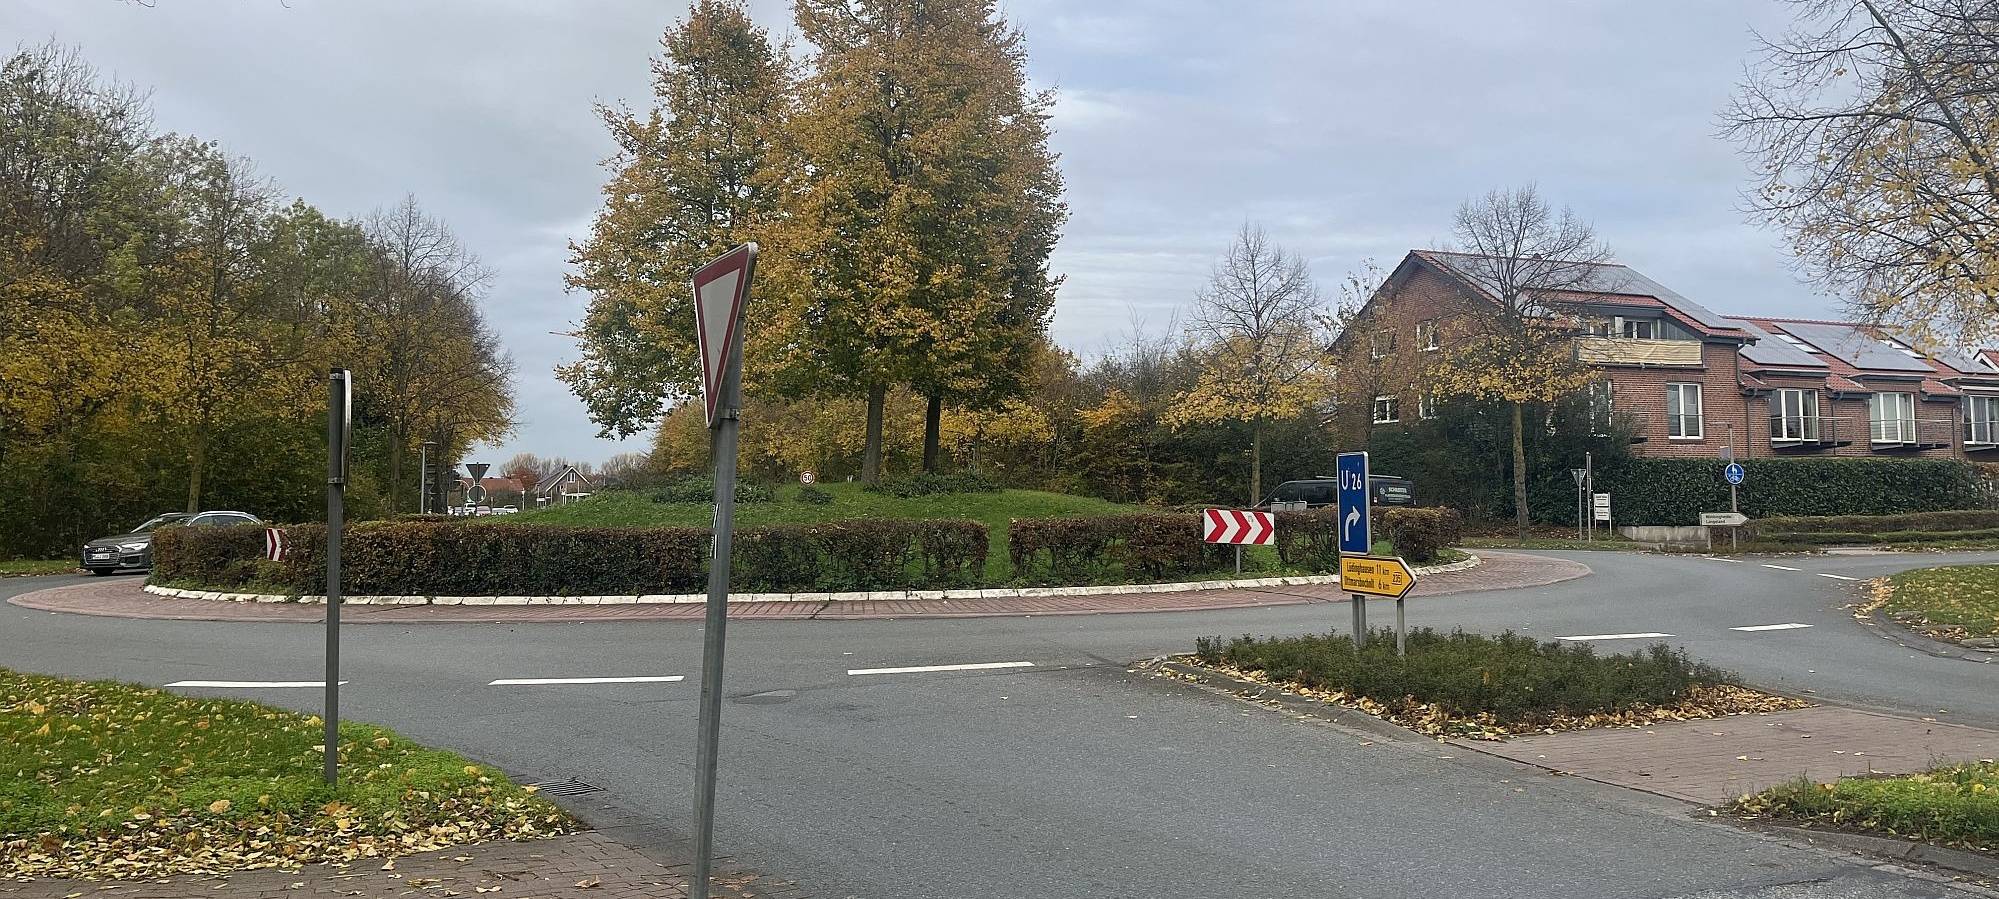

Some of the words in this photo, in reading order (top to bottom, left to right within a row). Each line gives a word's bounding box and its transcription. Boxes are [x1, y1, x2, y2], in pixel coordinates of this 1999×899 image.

[1341, 470, 1349, 490] U
[1351, 473, 1362, 490] 26
[1347, 562, 1374, 575] Lüdinghausen
[1376, 563, 1382, 575] 11
[1382, 567, 1390, 575] km
[1378, 578, 1382, 589] 6
[1382, 582, 1390, 590] km
[1393, 573, 1401, 583] 235
